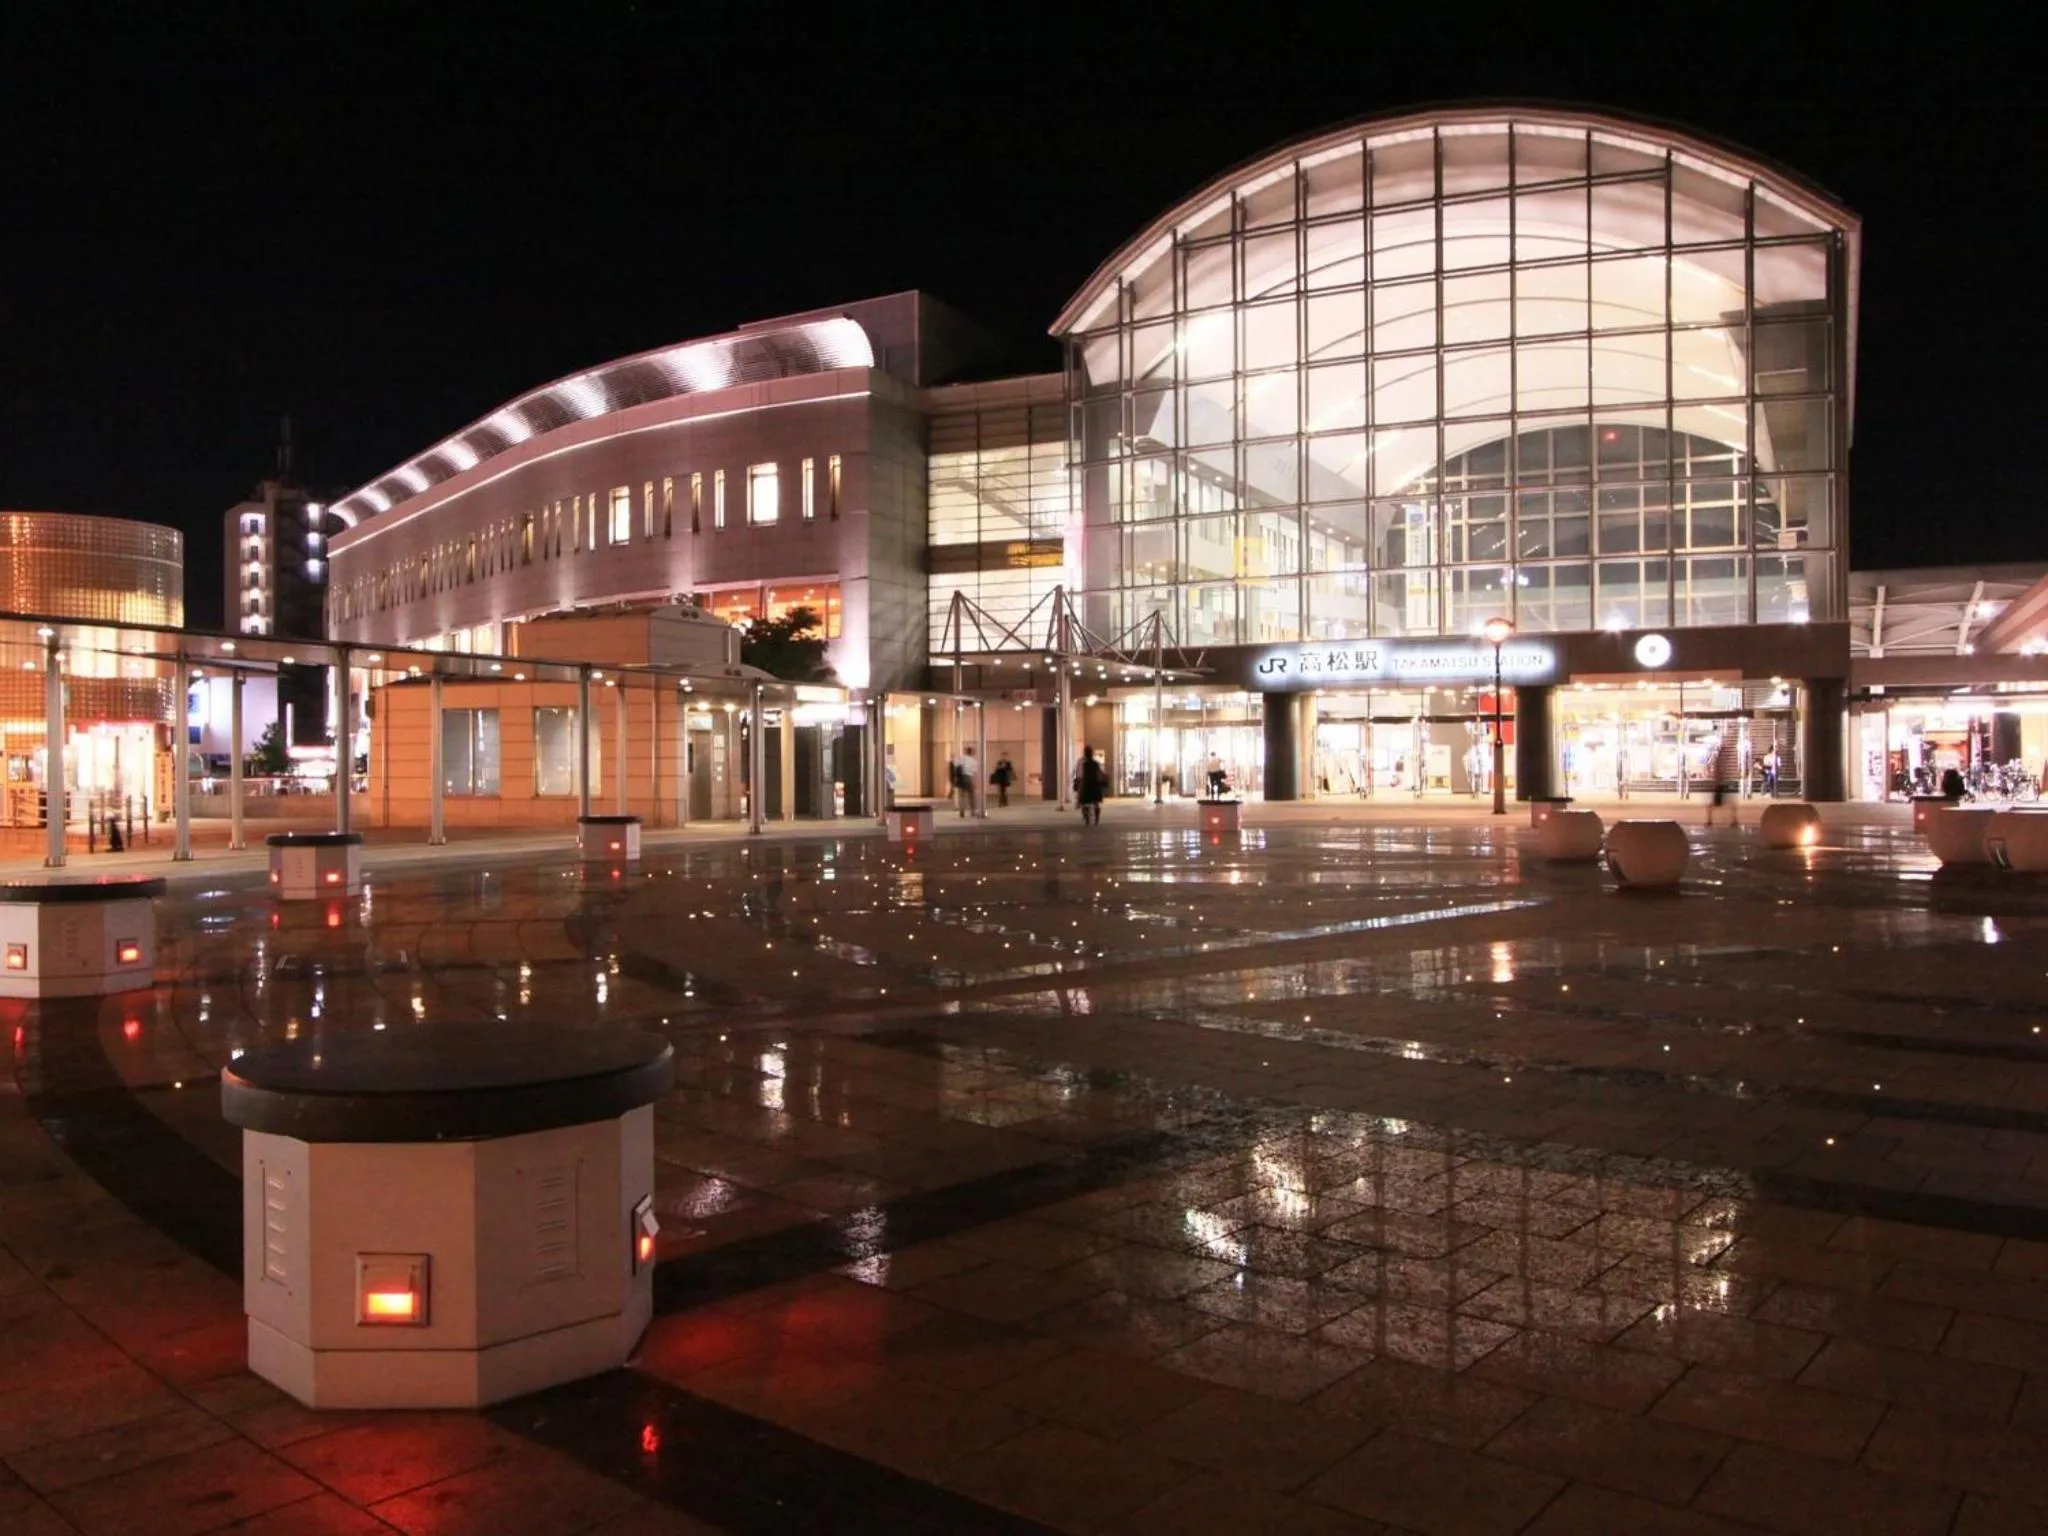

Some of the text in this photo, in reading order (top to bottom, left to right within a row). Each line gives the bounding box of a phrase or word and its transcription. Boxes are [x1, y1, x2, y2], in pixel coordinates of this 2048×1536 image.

[1259, 657, 1287, 674] JR
[1299, 650, 1378, 673] 高松駅
[1482, 653, 1543, 667] SATION
